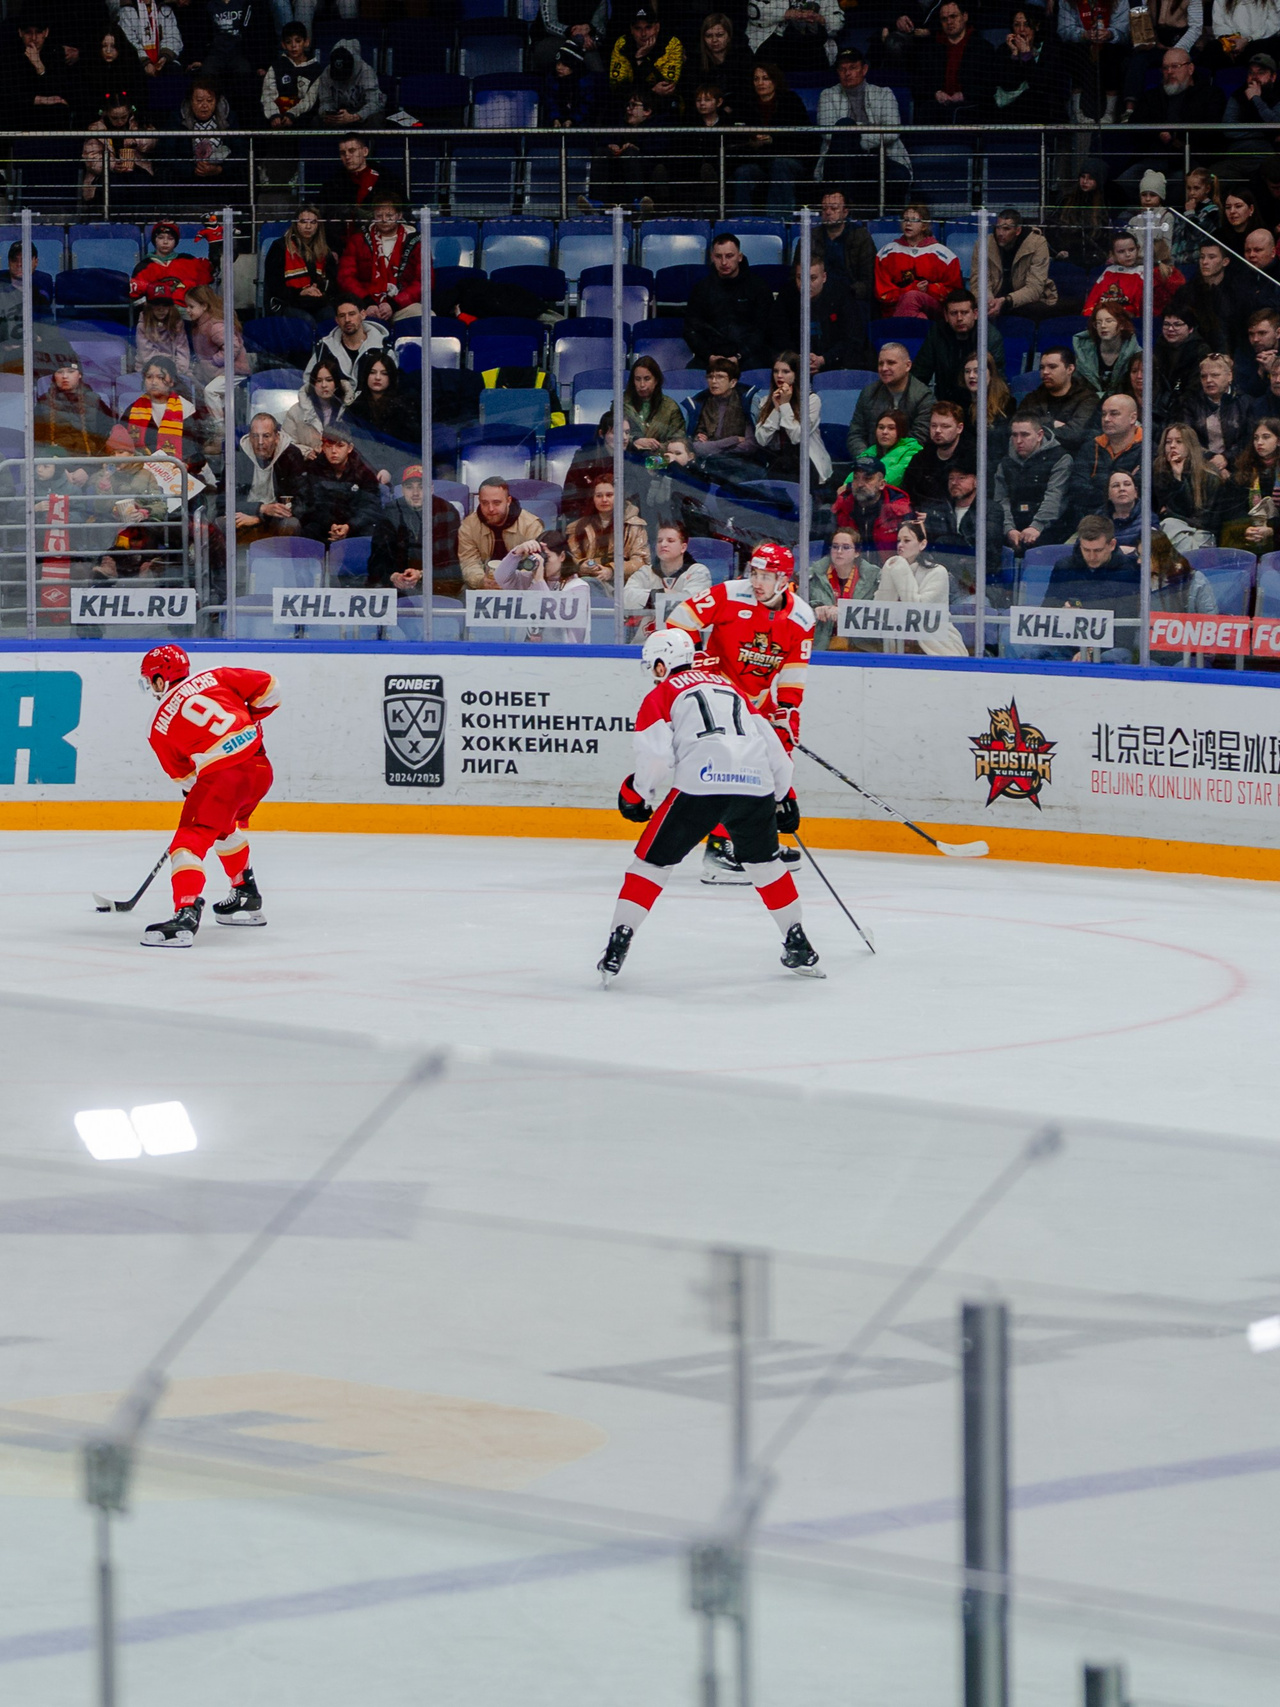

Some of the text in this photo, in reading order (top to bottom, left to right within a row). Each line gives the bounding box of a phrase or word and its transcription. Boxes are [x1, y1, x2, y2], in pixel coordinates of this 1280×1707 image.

[79, 595, 188, 617] KHL.RU
[280, 594, 389, 618] KHL.RU
[473, 596, 580, 620] KHL.RU
[692, 588, 716, 614] 92
[844, 605, 942, 633] KHL.RU
[1018, 613, 1108, 641] KHL.RU
[1151, 619, 1249, 648] FONBET
[388, 678, 440, 691] FONBET
[154, 672, 218, 736] HALBGEWACHS
[460, 690, 551, 707] ФОНБЕТ
[181, 694, 236, 736] 9
[684, 688, 746, 739] 17
[461, 733, 599, 754] ХОККЕЙНАЯ
[389, 772, 440, 784] 2024/2025
[461, 758, 519, 774] ЛИГА
[971, 749, 1055, 784] REDSTAR
[1091, 770, 1273, 806] BEIJING KUNLUN RED STAR
